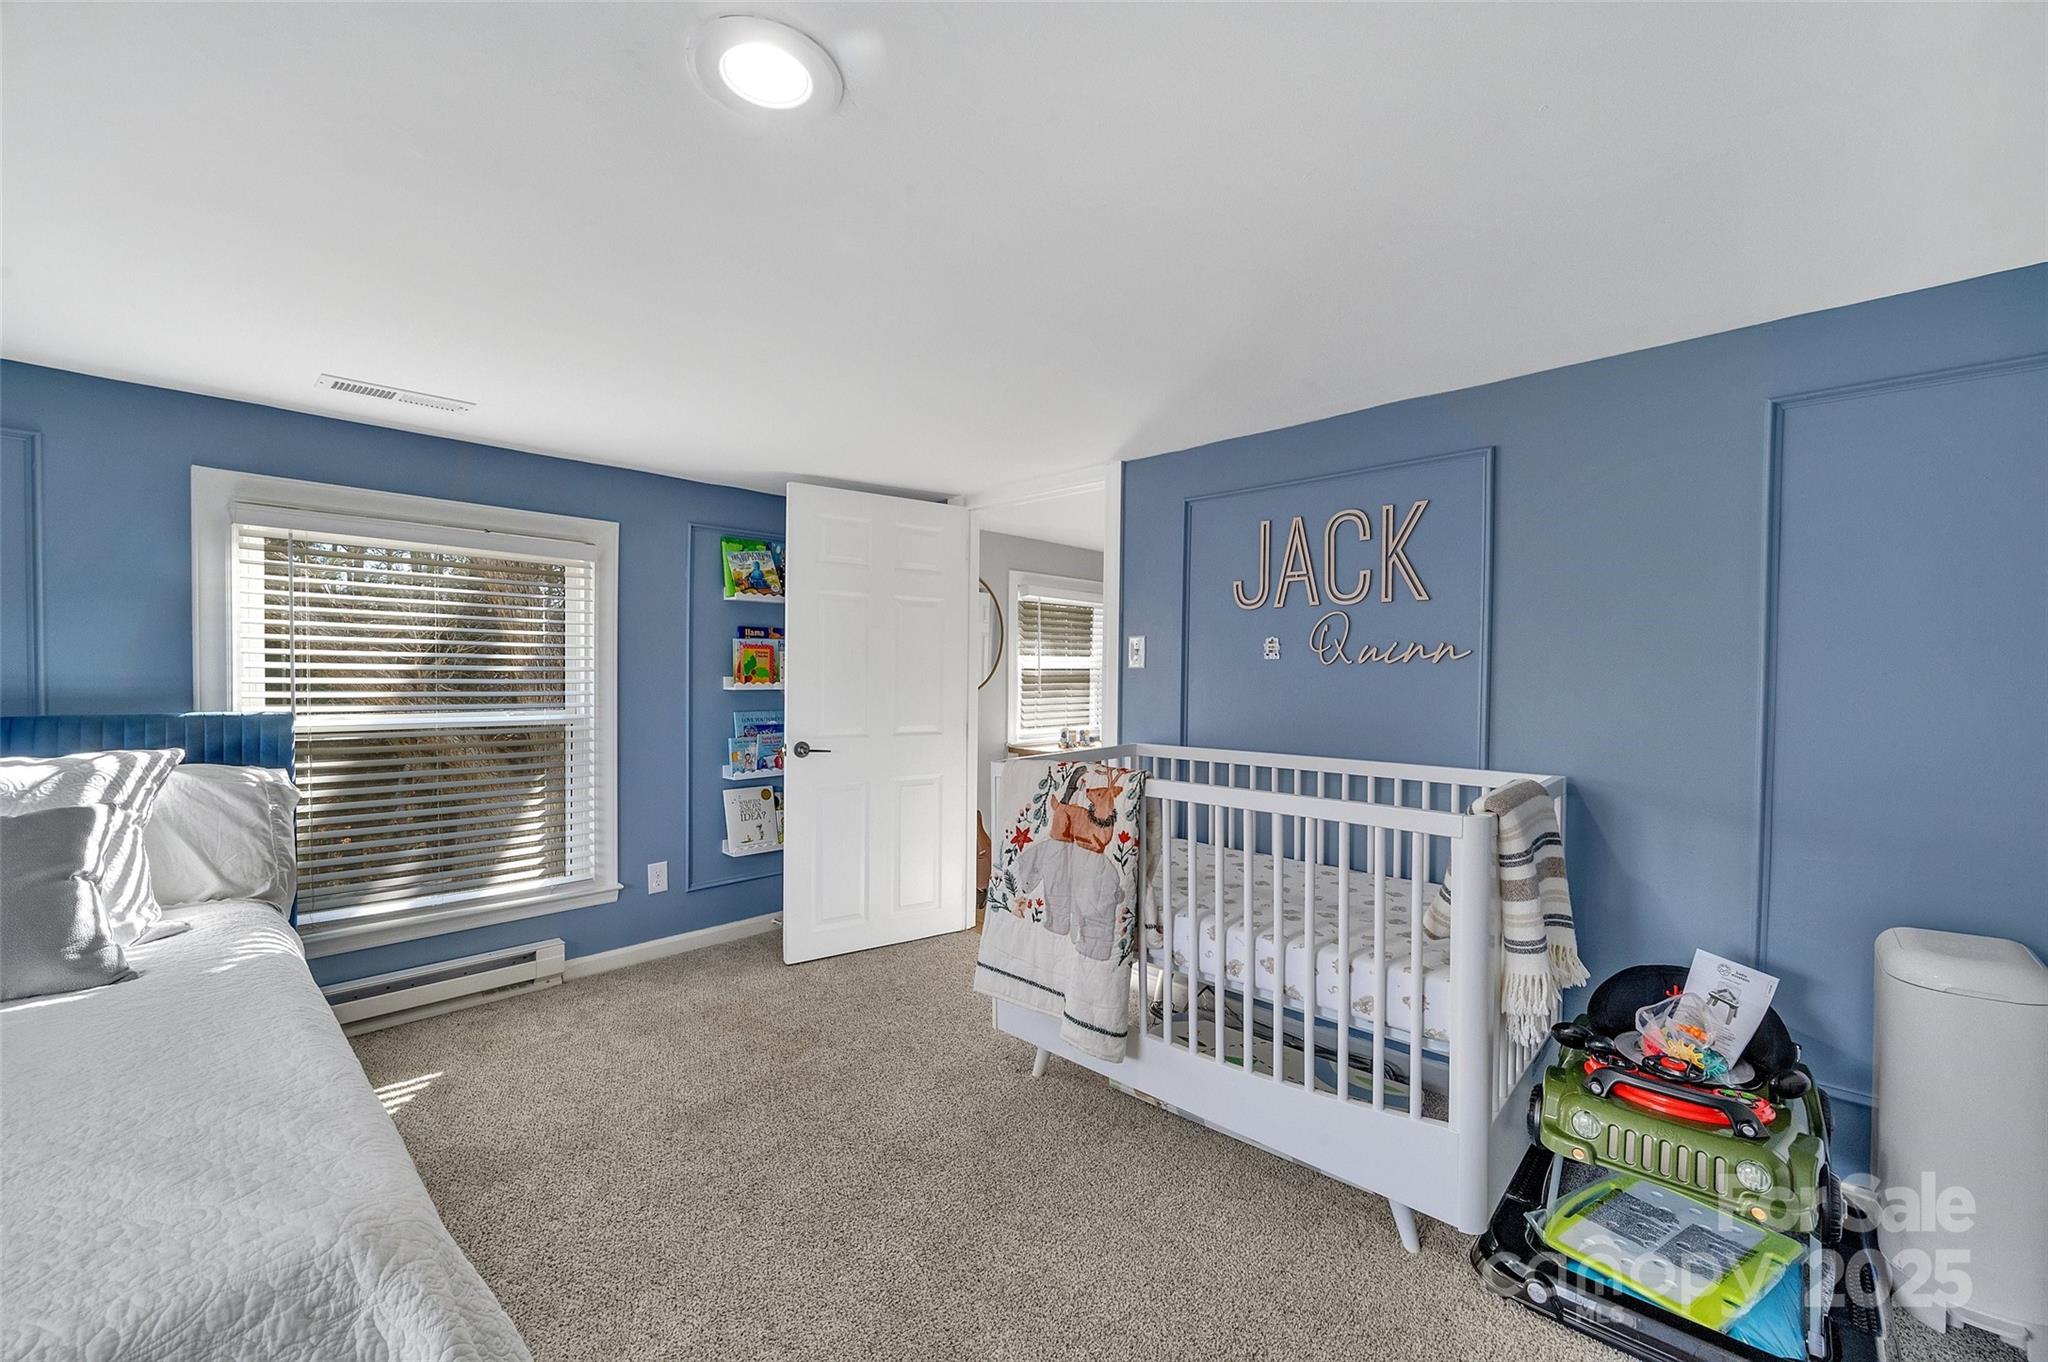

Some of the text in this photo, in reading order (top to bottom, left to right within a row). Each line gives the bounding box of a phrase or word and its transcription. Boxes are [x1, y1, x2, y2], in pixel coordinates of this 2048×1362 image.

[1232, 499, 1431, 611] JACK
[1308, 610, 1473, 666] Quinn
[740, 811, 767, 822] IDEA?
